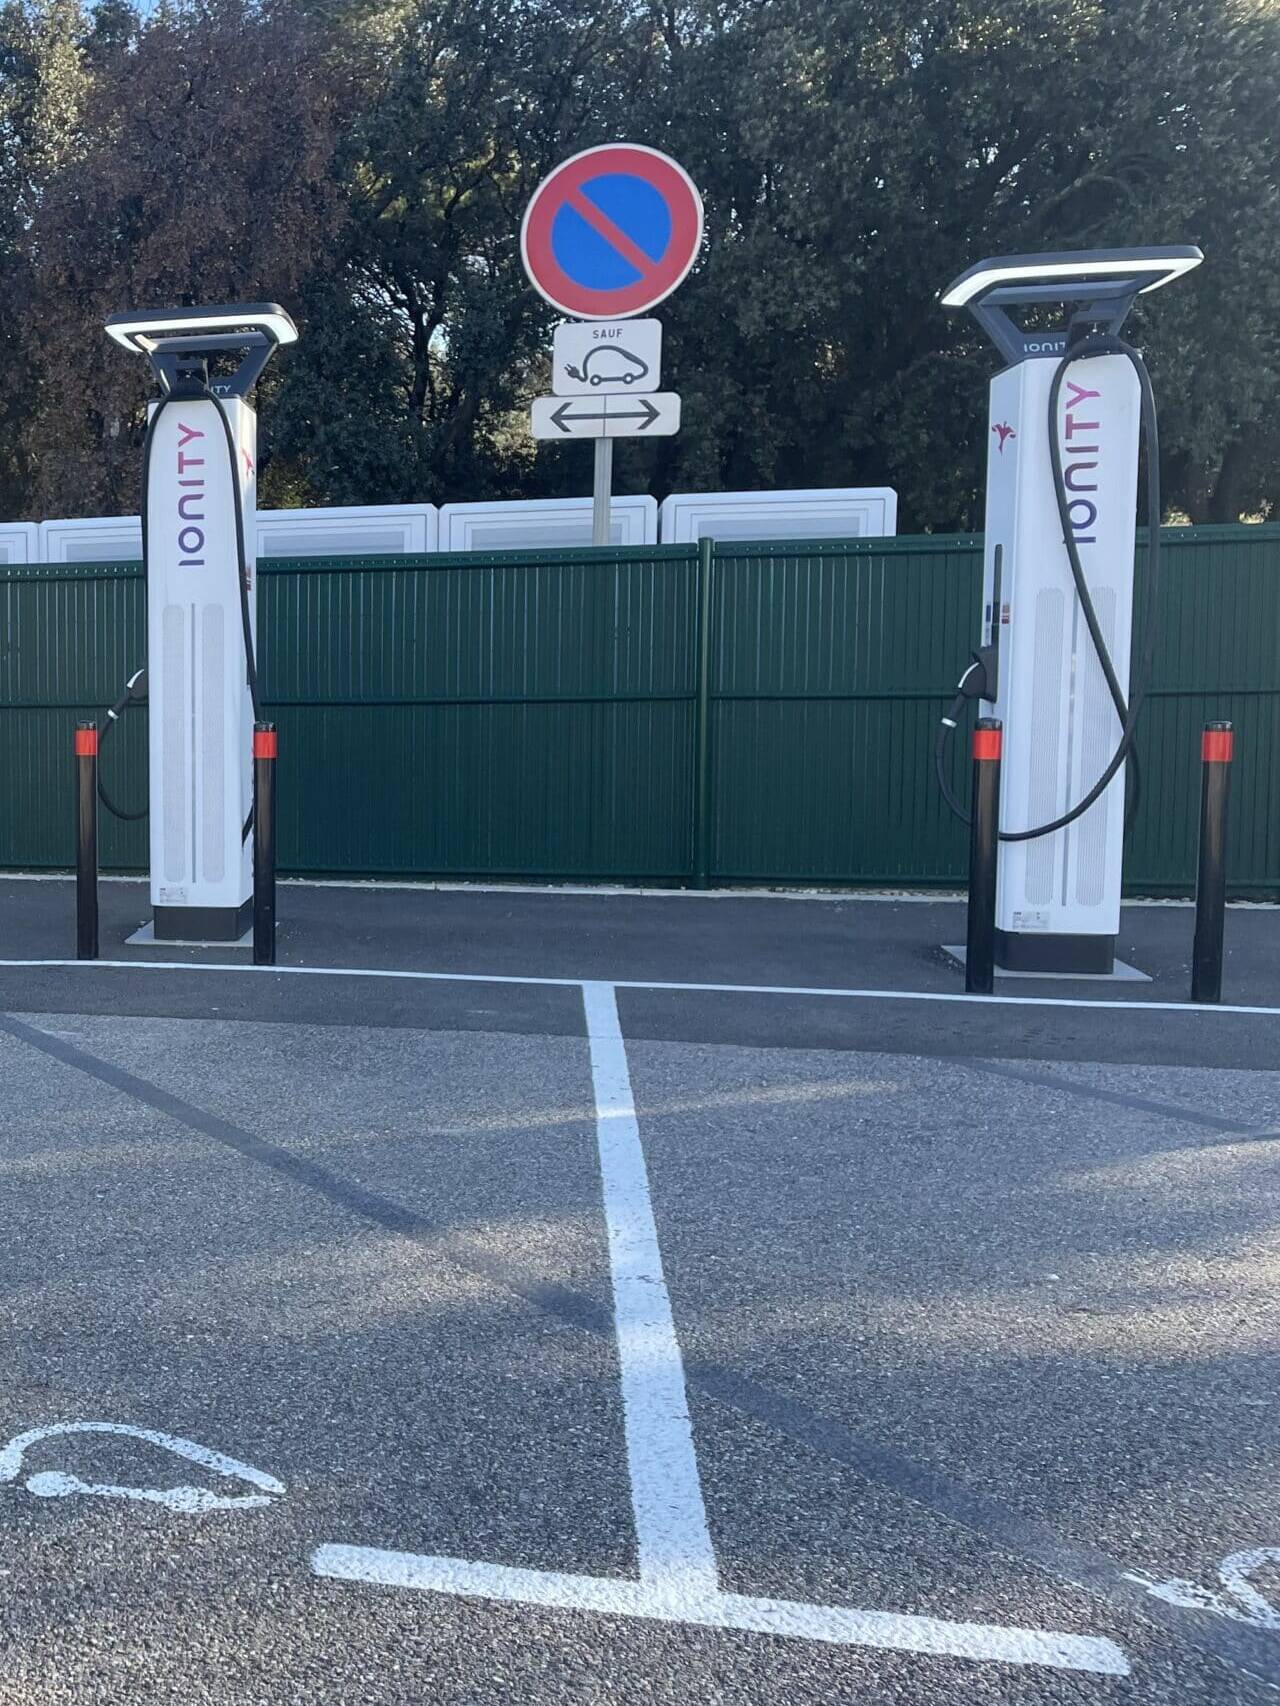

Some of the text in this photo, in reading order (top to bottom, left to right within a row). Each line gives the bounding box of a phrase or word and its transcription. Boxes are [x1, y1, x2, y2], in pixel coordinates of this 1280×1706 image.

[592, 328, 623, 339] SAUF
[1024, 341, 1066, 352] IONIT
[178, 423, 205, 566] IONITY
[1064, 381, 1101, 544] IONITY
